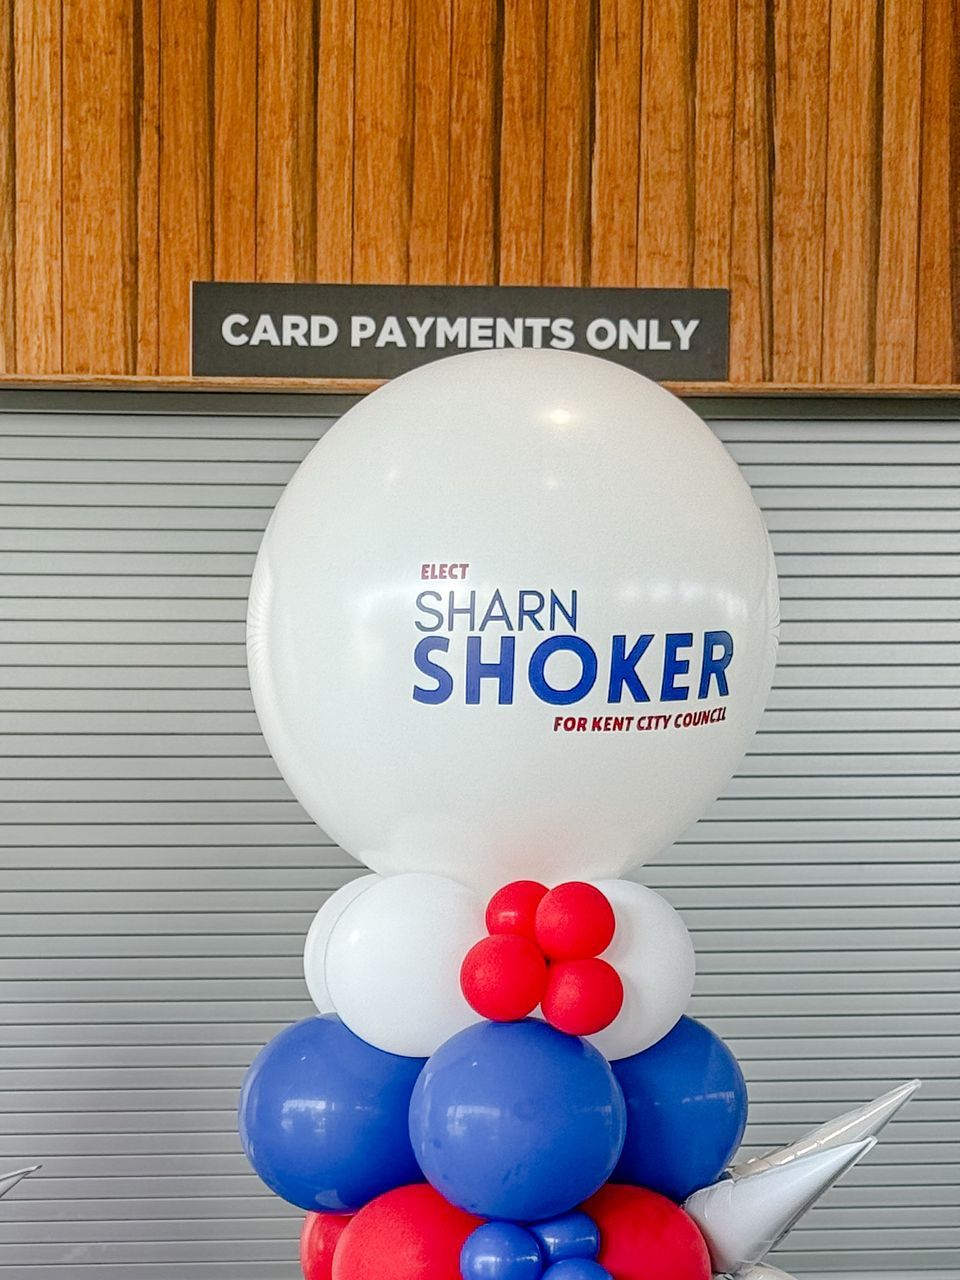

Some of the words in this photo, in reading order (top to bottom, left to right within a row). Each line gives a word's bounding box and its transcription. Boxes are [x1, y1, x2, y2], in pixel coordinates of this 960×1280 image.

[221, 313, 339, 347] CARD
[350, 315, 576, 350] PAYMENTS
[586, 318, 700, 351] ONLY
[420, 563, 469, 580] ELECT
[414, 588, 578, 632] SHARN
[412, 630, 735, 705] SHOKER
[553, 716, 587, 732] FOR
[591, 715, 634, 732] KENT
[636, 713, 672, 731] CITY
[674, 706, 728, 728] COUNCIL
